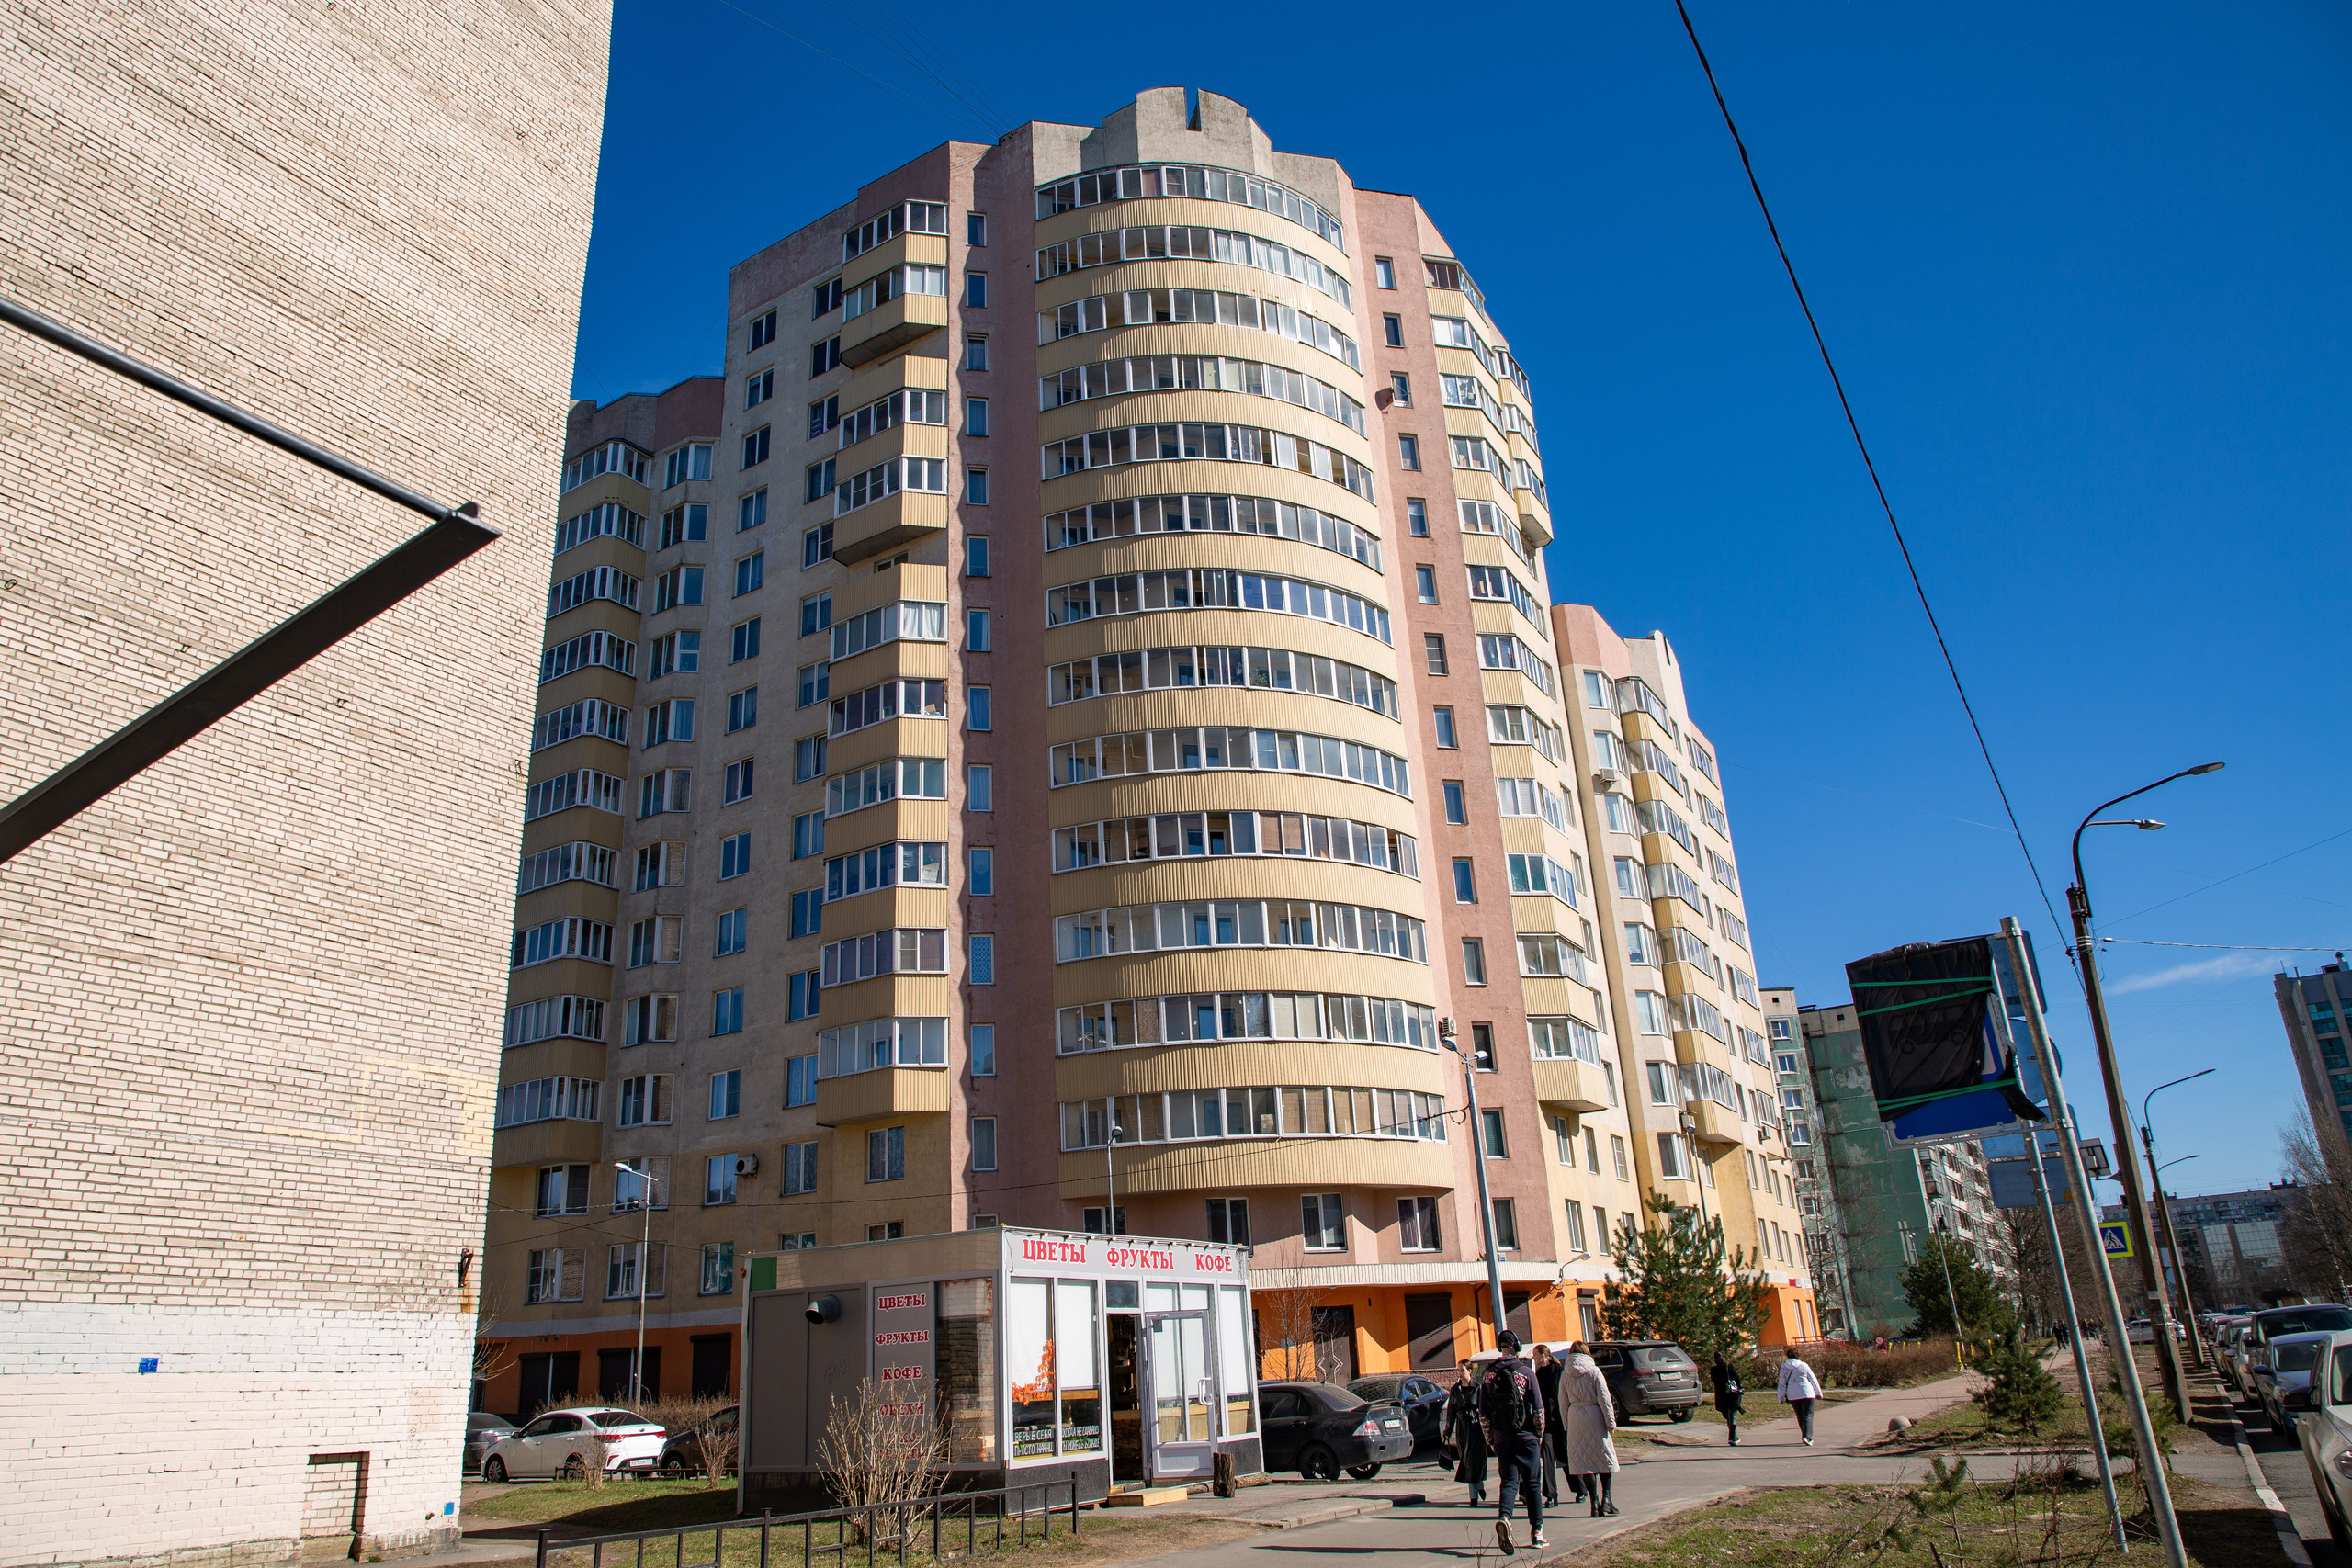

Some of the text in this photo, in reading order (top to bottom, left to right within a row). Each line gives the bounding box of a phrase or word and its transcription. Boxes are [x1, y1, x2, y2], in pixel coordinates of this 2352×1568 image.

[1023, 1238, 1233, 1272] ЦВЕТЫ ФРУКТЫ КОФЕ
[878, 1293, 926, 1312] ЦВЕТЫ
[876, 1330, 929, 1345] ФРУКТЫ
[883, 1365, 922, 1381] КОФЕ
[1014, 1429, 1052, 1442] ВЕРЬ В СЕБЯ
